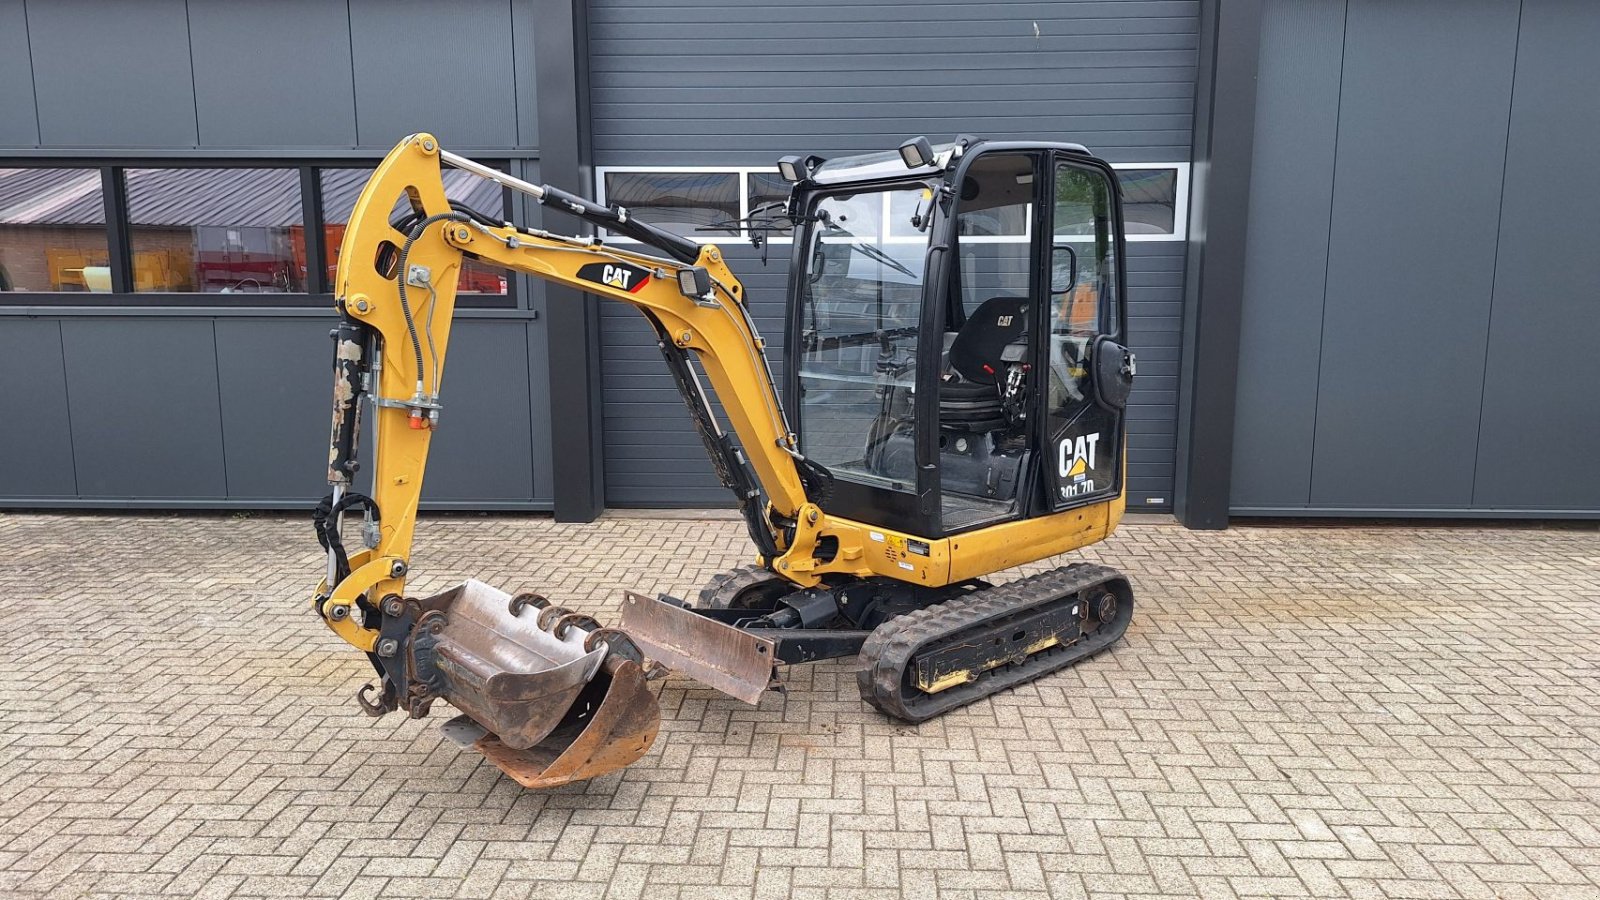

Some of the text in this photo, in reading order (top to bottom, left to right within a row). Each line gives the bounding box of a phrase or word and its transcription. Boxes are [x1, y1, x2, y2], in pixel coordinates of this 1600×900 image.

[602, 264, 632, 289] CAT
[997, 315, 1014, 327] CAT
[1059, 432, 1100, 478] CAT
